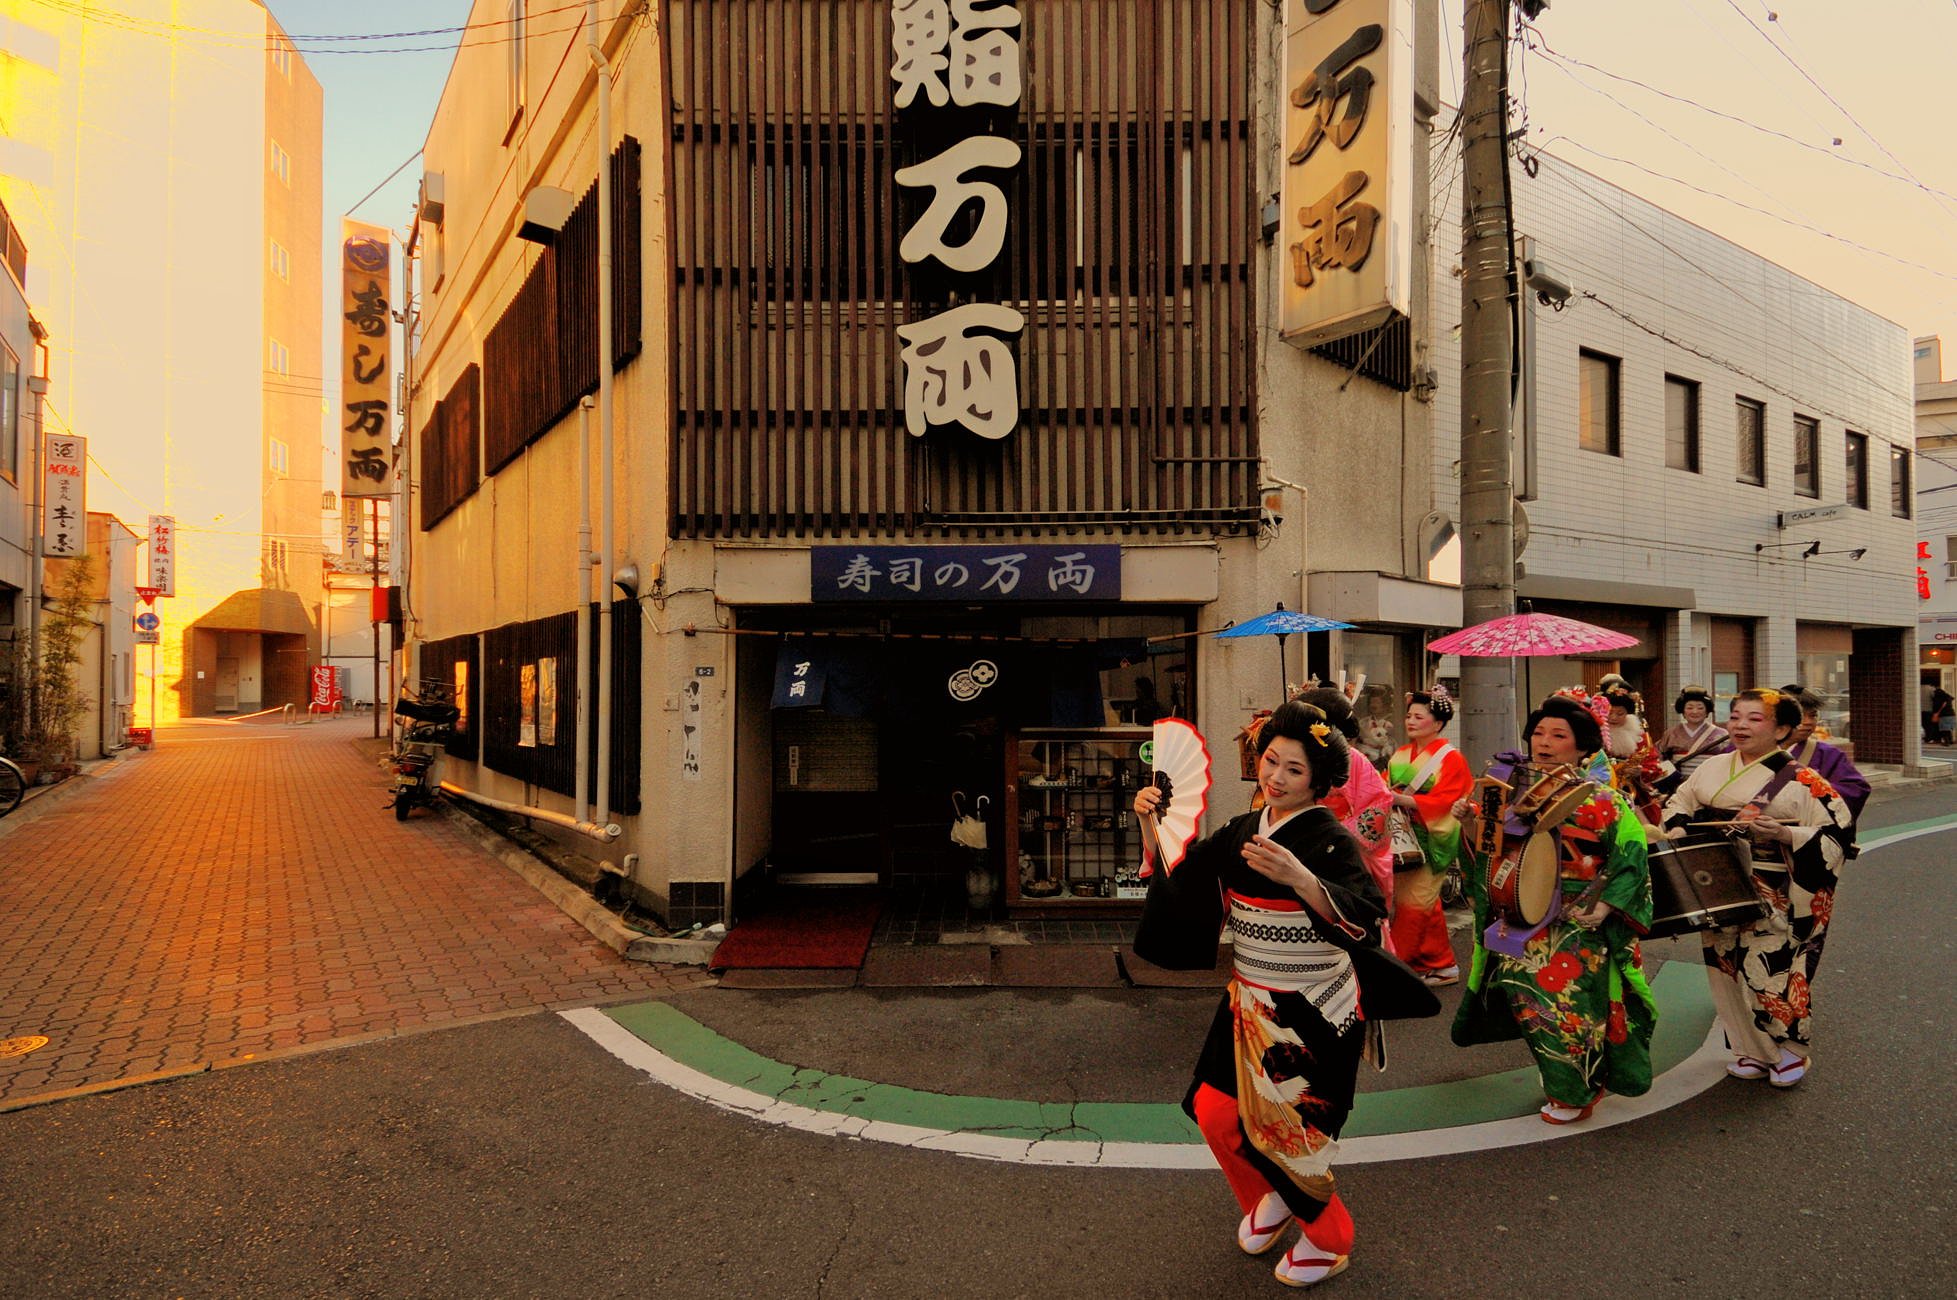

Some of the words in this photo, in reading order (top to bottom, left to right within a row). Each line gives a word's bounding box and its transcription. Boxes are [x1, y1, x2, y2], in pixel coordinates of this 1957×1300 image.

[837, 551, 1096, 594] 寿司の万両
[789, 661, 811, 697] 万両
